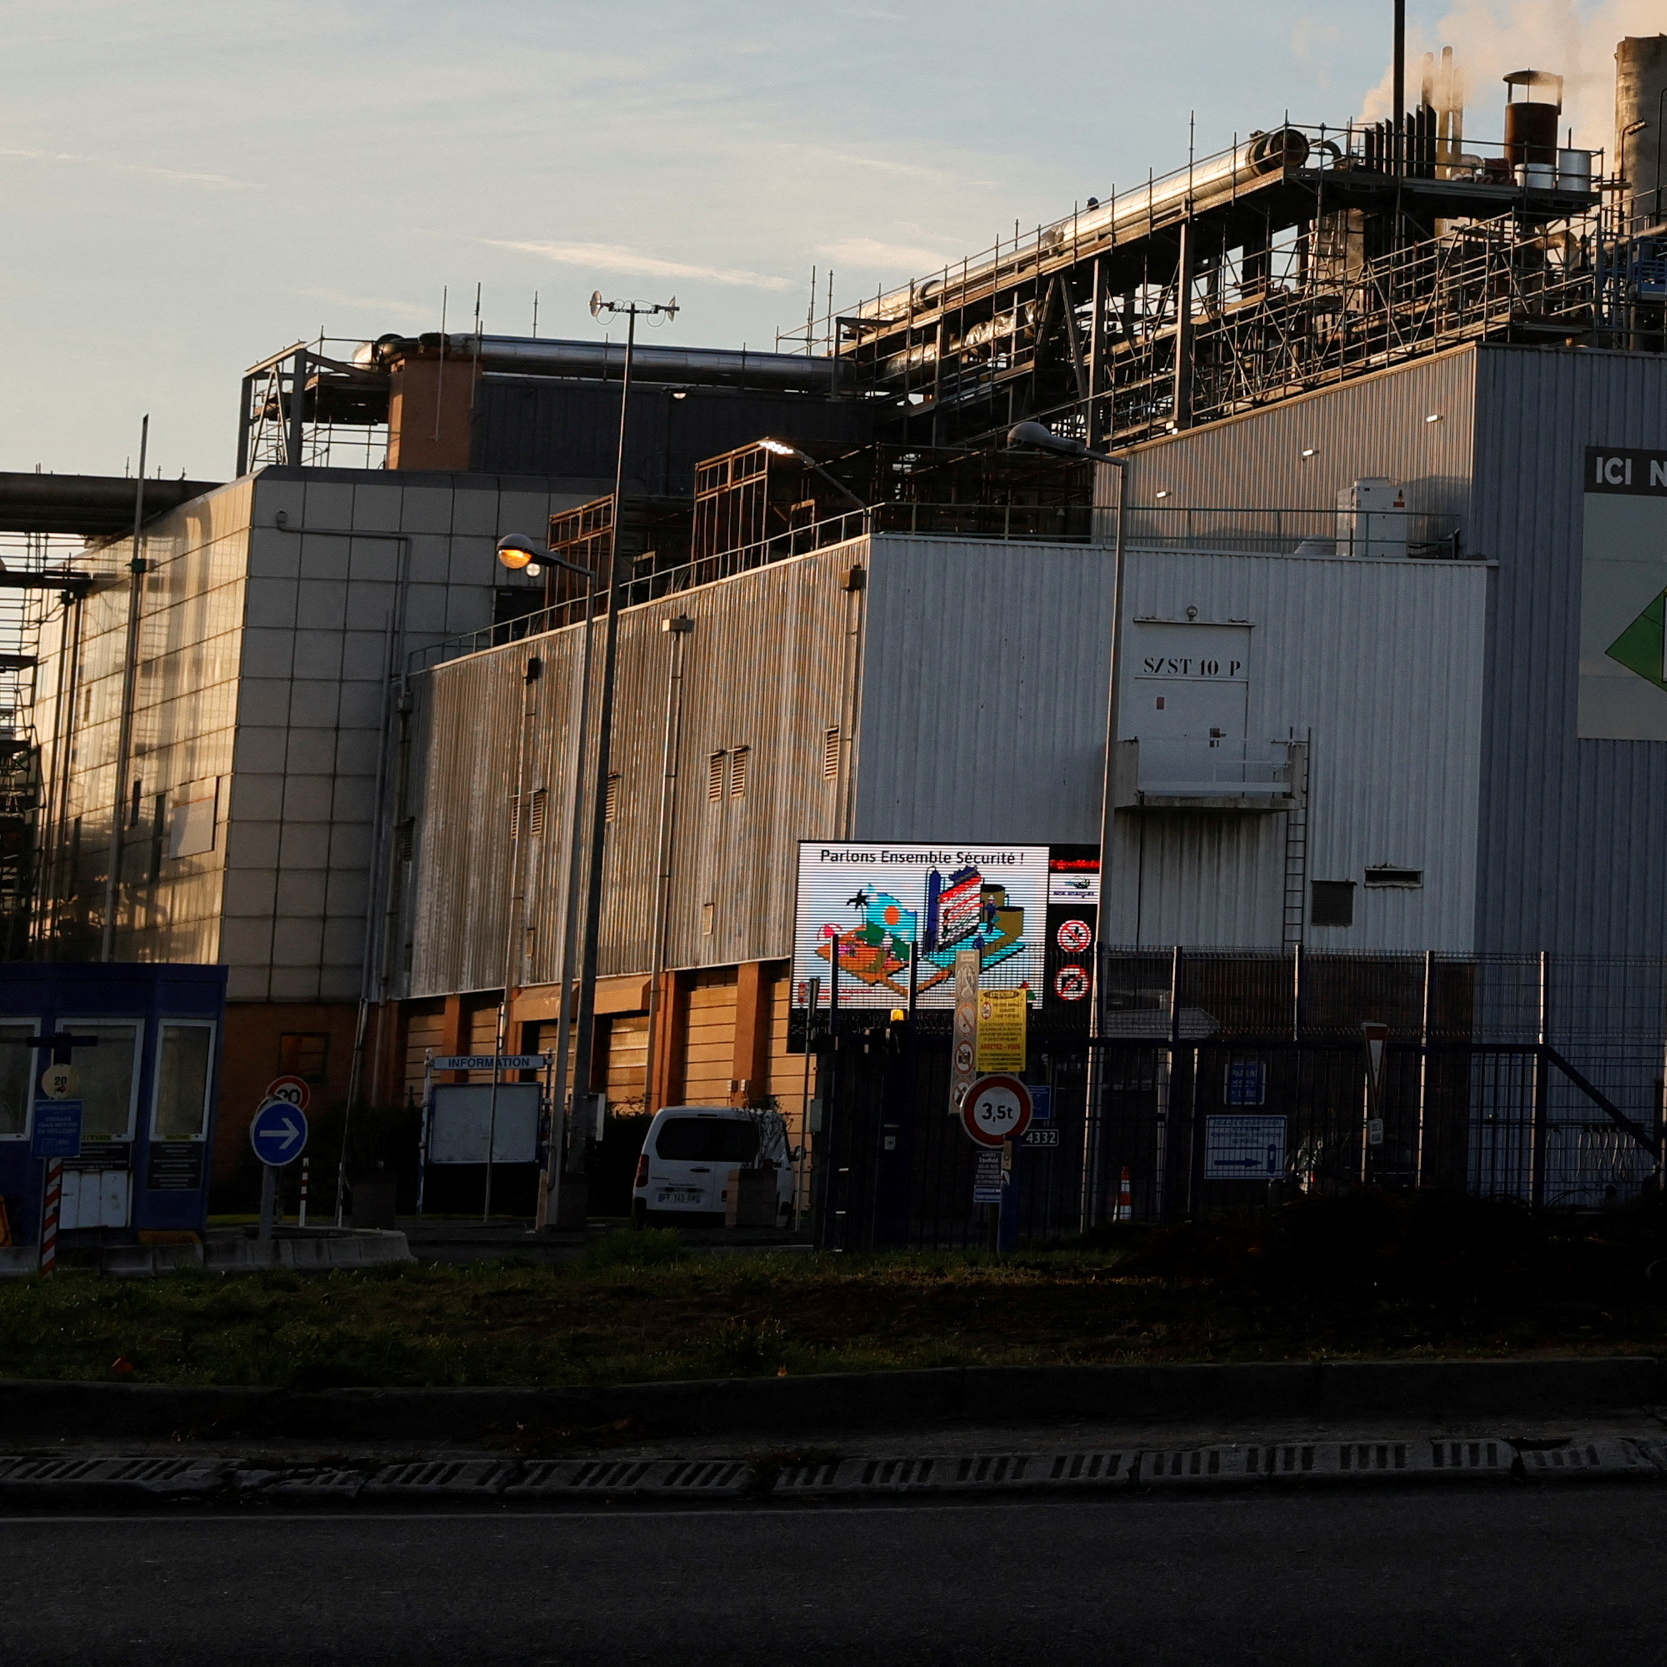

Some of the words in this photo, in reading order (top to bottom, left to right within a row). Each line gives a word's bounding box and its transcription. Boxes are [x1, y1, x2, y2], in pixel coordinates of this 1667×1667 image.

[1595, 456, 1632, 485] ICI
[1143, 657, 1192, 675] S/ST
[1200, 659, 1219, 676] 10
[1229, 660, 1241, 677] P
[820, 849, 876, 863] Parlons
[881, 850, 951, 864] Ensemble
[956, 851, 1016, 865] Sécurité
[448, 1057, 530, 1068] INFORMATION
[54, 1076, 67, 1086] 20
[981, 1102, 1013, 1122] 3,5t
[1025, 1131, 1057, 1144] 4332
